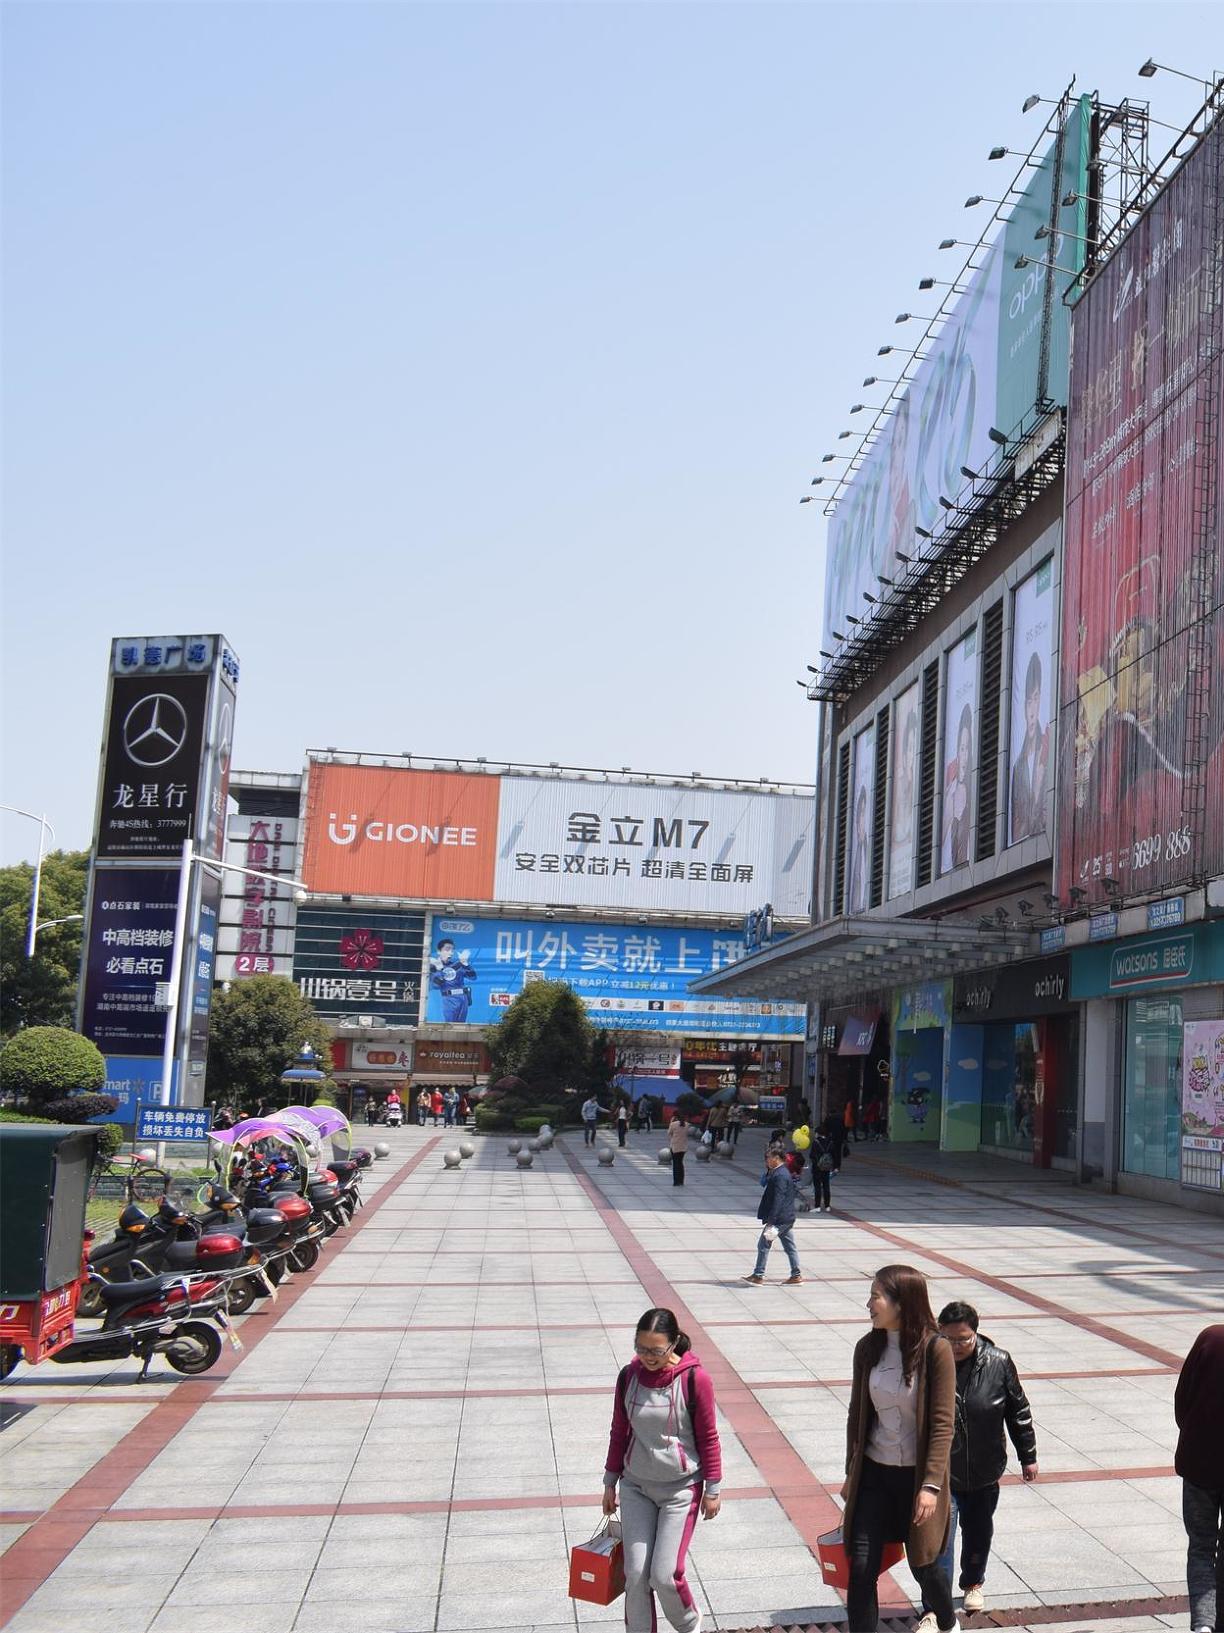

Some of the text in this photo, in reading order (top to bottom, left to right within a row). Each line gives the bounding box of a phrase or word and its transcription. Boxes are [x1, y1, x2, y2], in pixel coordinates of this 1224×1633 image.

[121, 644, 206, 667] 凯德广场
[112, 783, 188, 808] 龙星行
[365, 822, 477, 846] GIONEE
[566, 812, 710, 849] 金立M7
[515, 852, 754, 884] 安全双芯片 超清全面屏
[102, 927, 174, 948] 中高档装修
[106, 956, 164, 975] 必看点石
[238, 956, 270, 972] 2层
[1115, 945, 1186, 976] watsons 屈臣氏
[300, 978, 397, 1002] 川锅壹号
[966, 986, 991, 1008] ochirly
[1035, 973, 1064, 999] ochirly
[143, 1110, 206, 1124] 车辆免费停放
[142, 1124, 205, 1138] 损坏丢失自负
